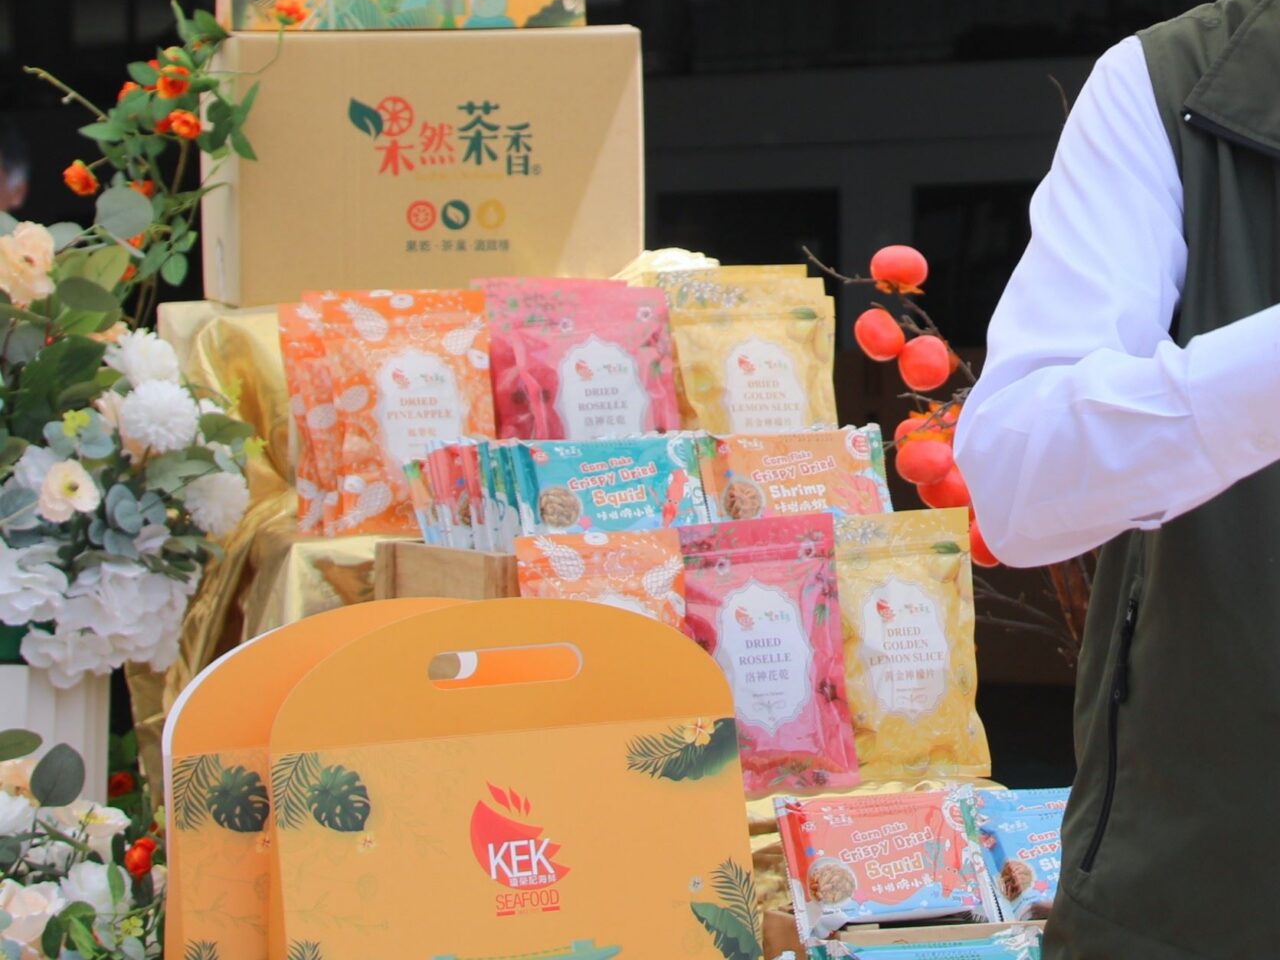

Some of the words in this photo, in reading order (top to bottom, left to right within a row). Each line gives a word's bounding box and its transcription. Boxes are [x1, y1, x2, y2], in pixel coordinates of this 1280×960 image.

[585, 387, 619, 397] DRIED
[578, 400, 628, 411] ROSELLE
[581, 461, 608, 473] Corn
[752, 467, 796, 483] Crispy
[800, 456, 836, 475] Dried
[568, 473, 616, 491] Crispy
[620, 462, 657, 482] Dried
[593, 485, 646, 507] Squid
[769, 483, 826, 499] Shrimp
[888, 626, 921, 637] DRIED
[745, 638, 781, 649] DRIED
[883, 639, 929, 651] GOLDEN
[739, 652, 792, 665] ROSELLE
[870, 653, 911, 666] LEMON
[912, 651, 944, 662] SLICE
[852, 828, 881, 843] Corn
[1028, 830, 1057, 842] Corn
[839, 840, 889, 864] Crispy
[893, 827, 933, 850] Dried
[488, 838, 555, 880] KEK
[865, 852, 925, 880] Squid
[495, 889, 560, 910] SEAFOOD
